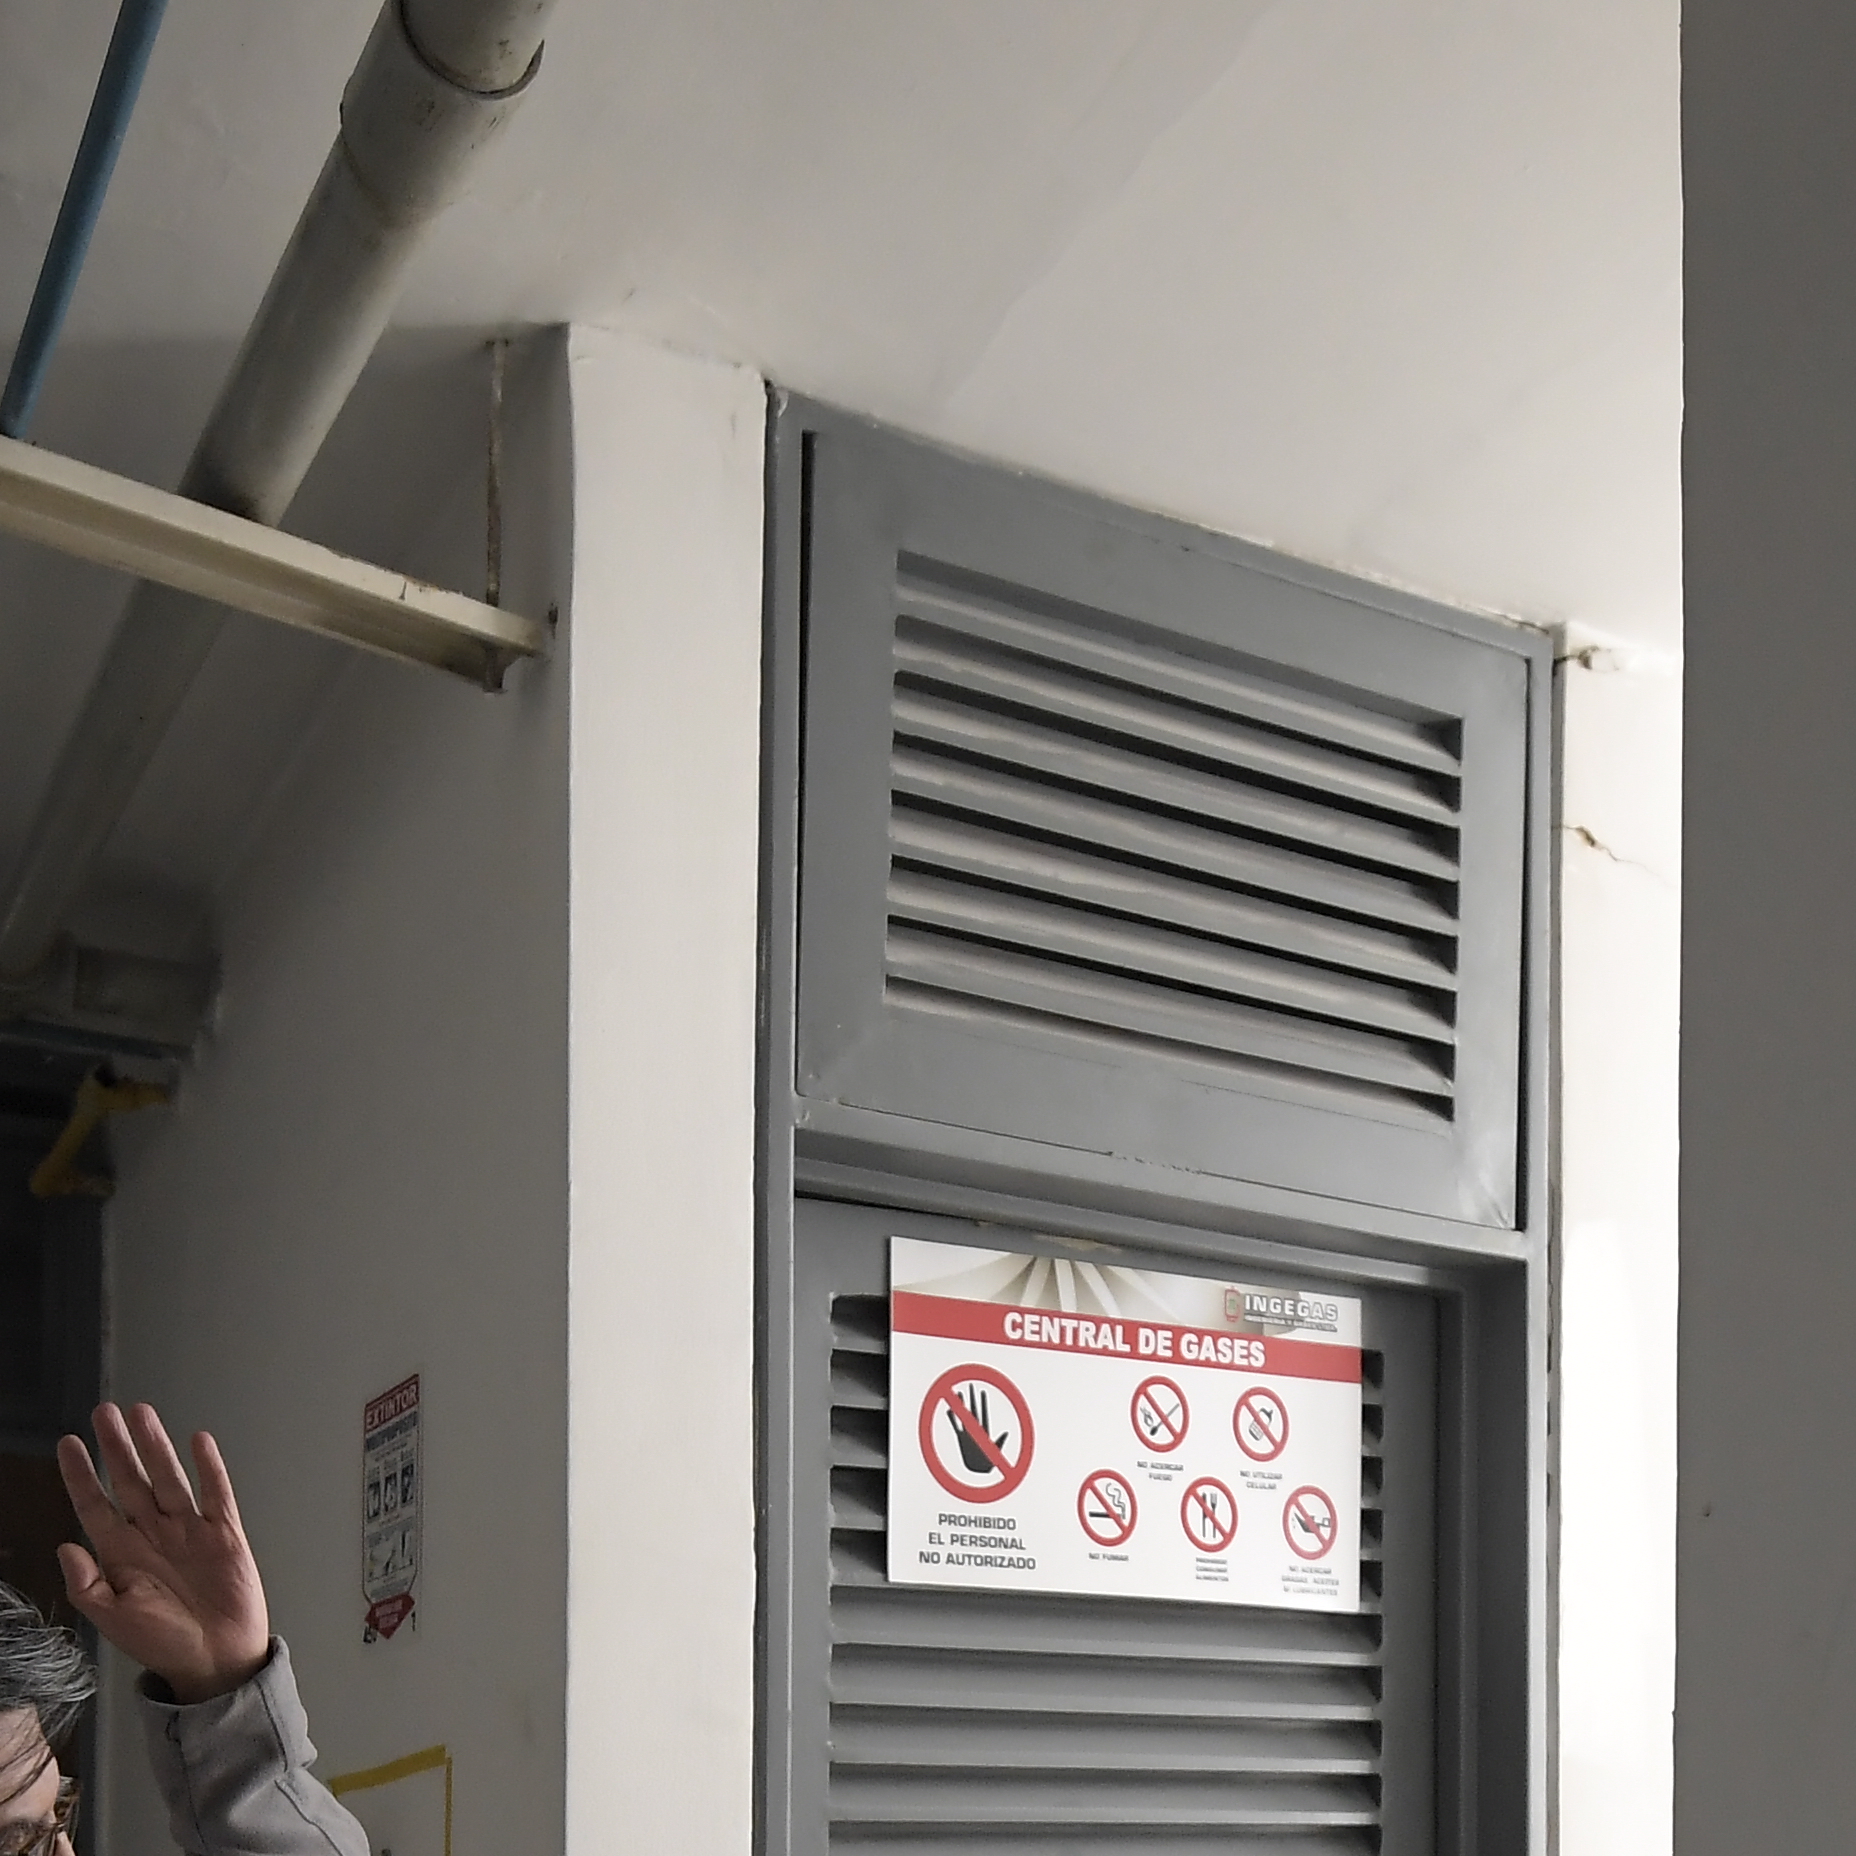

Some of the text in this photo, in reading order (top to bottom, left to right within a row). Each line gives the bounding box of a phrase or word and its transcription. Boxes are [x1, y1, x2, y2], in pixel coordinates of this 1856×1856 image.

[1245, 1293, 1338, 1322] INGEGAS
[1003, 1312, 1266, 1368] CENTRAL DE GASES
[938, 1513, 1017, 1530] PROHIBIDO
[928, 1531, 1026, 1550] EL PERSONAL
[918, 1551, 1036, 1570] NO AUTORIZADO
